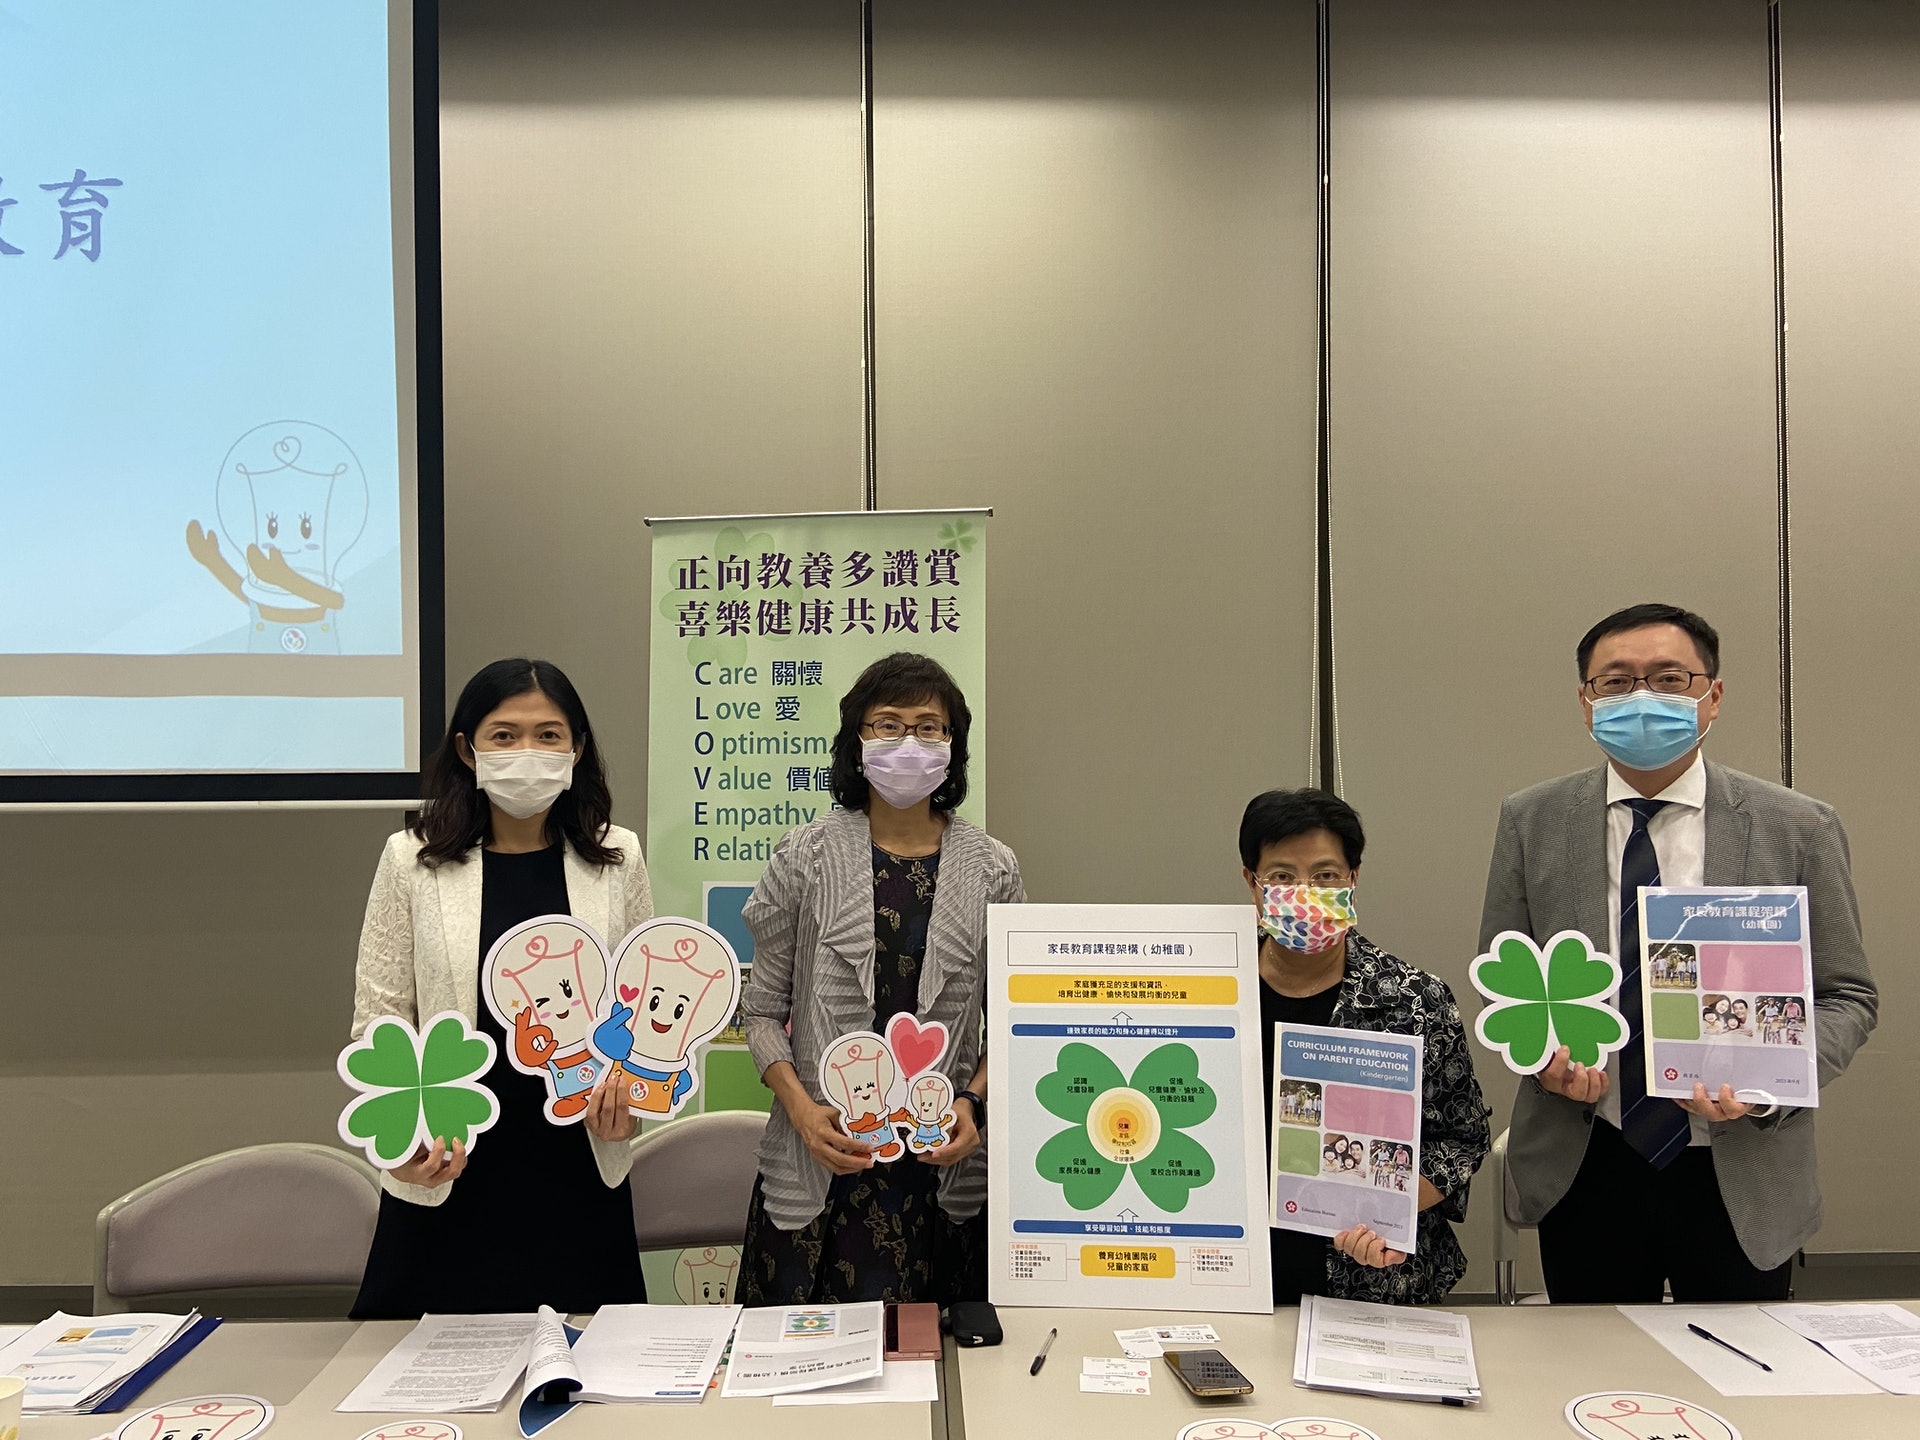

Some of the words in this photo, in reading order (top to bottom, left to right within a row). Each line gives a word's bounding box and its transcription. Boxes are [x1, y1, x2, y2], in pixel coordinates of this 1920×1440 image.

[0, 169, 124, 262] 育
[675, 549, 961, 591] 正向教養多讚賞
[675, 596, 961, 637] 喜樂健康共成長
[772, 660, 823, 686] 關懷
[775, 695, 800, 721] 愛
[694, 730, 827, 761] Optimism
[786, 766, 833, 791] 價值
[694, 837, 772, 861] Relati
[1287, 1040, 1346, 1053] CURRICULUM
[1349, 1046, 1409, 1061] FRAMEWORK
[1302, 1052, 1316, 1061] ON
[1318, 1054, 1353, 1065] PARENT
[1356, 1058, 1409, 1071] EDUCATION
[1359, 1070, 1409, 1083] (Kindergarten)
[1107, 1262, 1149, 1273] 兒童的家庭
